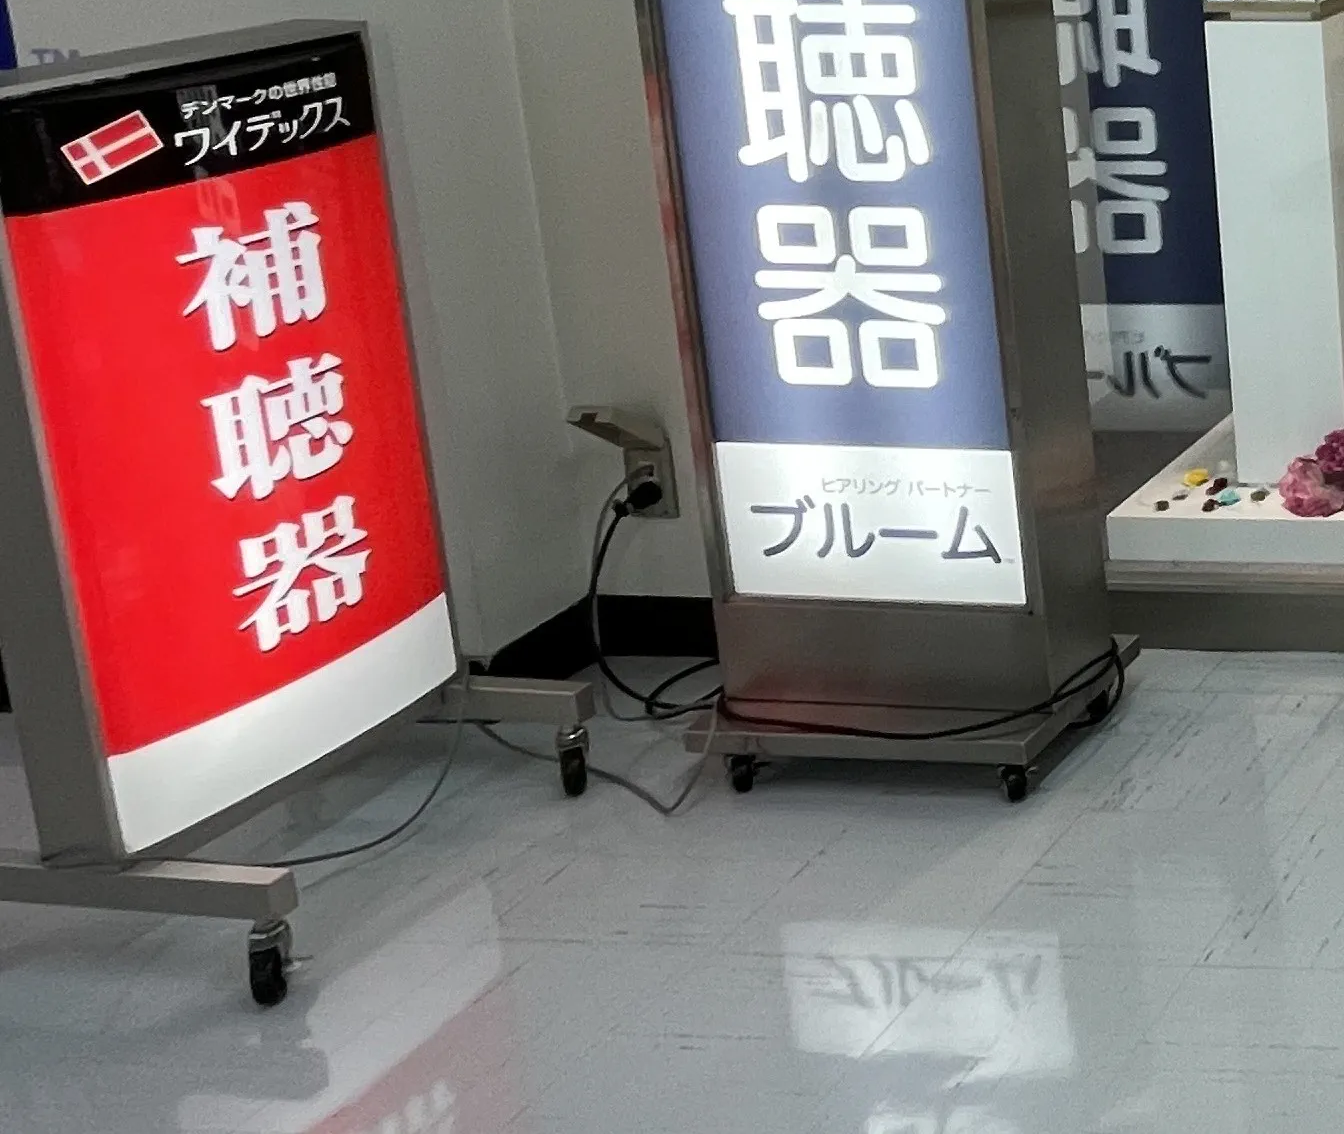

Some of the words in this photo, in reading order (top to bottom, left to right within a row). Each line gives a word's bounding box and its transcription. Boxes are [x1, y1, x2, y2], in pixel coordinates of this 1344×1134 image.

[174, 96, 351, 166] ワイデックス
[175, 201, 372, 653] 補聴器
[821, 477, 901, 496] ヒアリング
[908, 480, 992, 498] パートナー
[750, 494, 1001, 564] ブルーム
